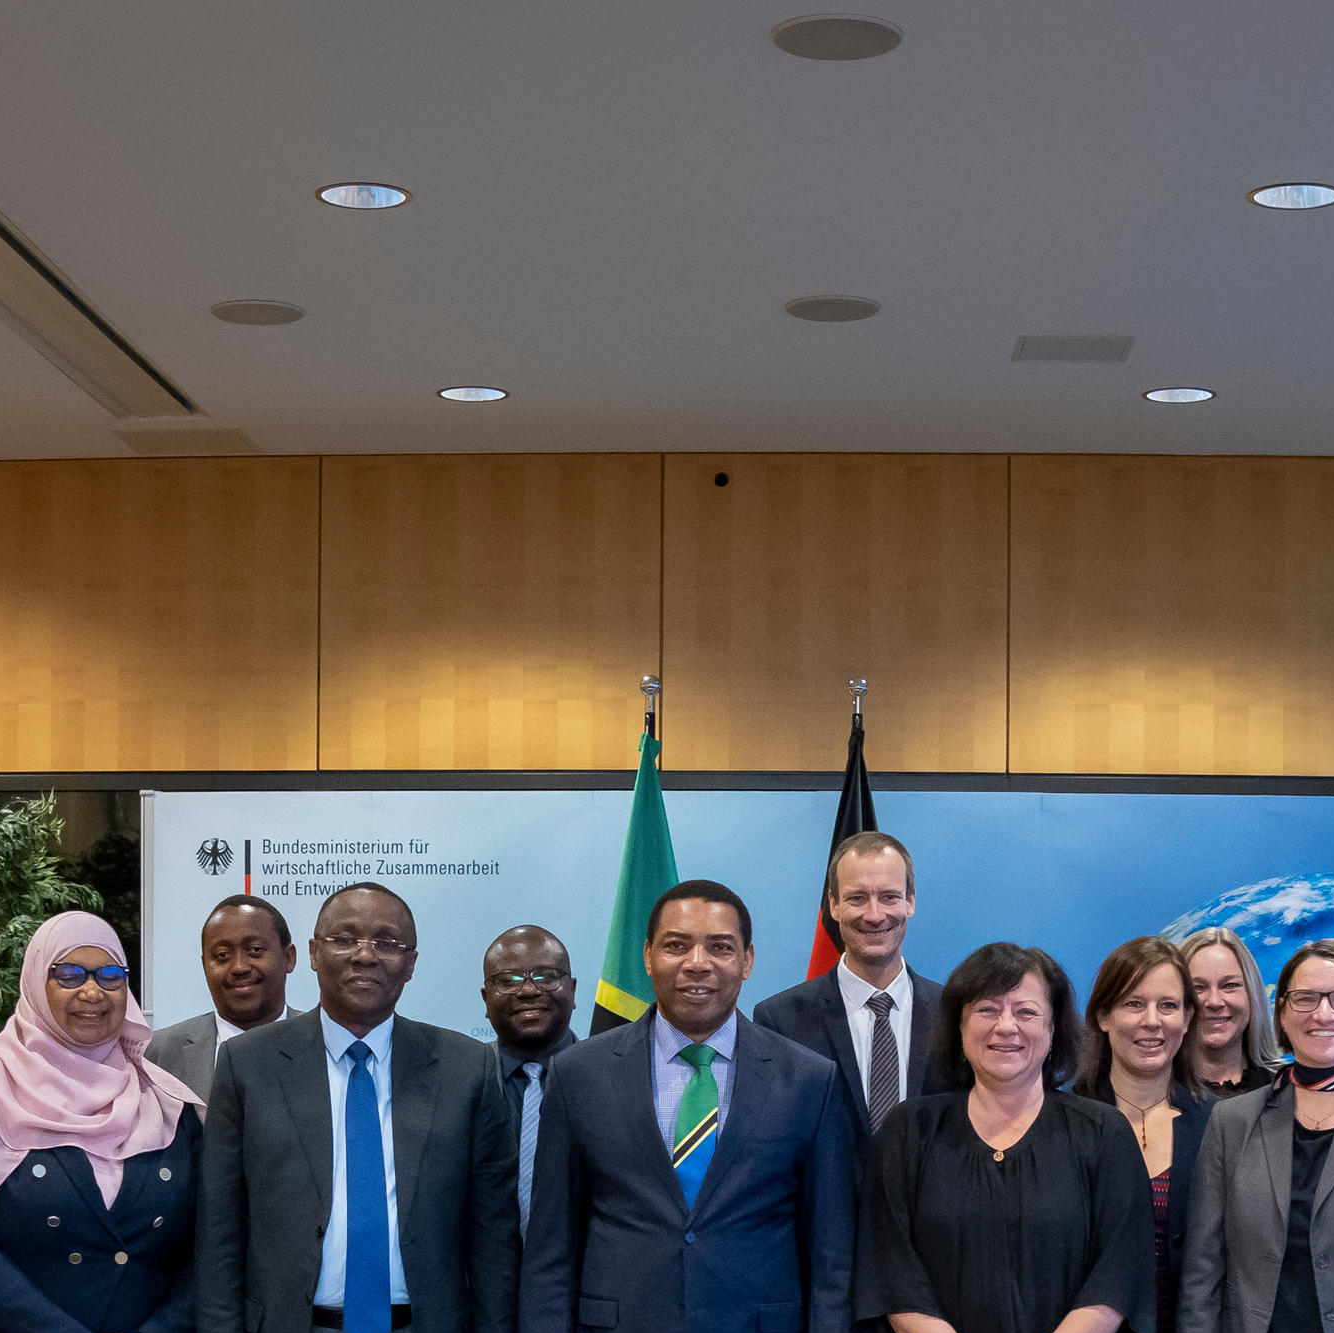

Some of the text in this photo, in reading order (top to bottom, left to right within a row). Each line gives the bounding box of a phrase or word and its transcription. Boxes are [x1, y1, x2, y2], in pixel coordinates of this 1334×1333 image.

[262, 839, 430, 854] Bundesministerium für
[262, 859, 500, 875] wirtschaftliche Zusammenarbeit
[262, 881, 289, 896] und
